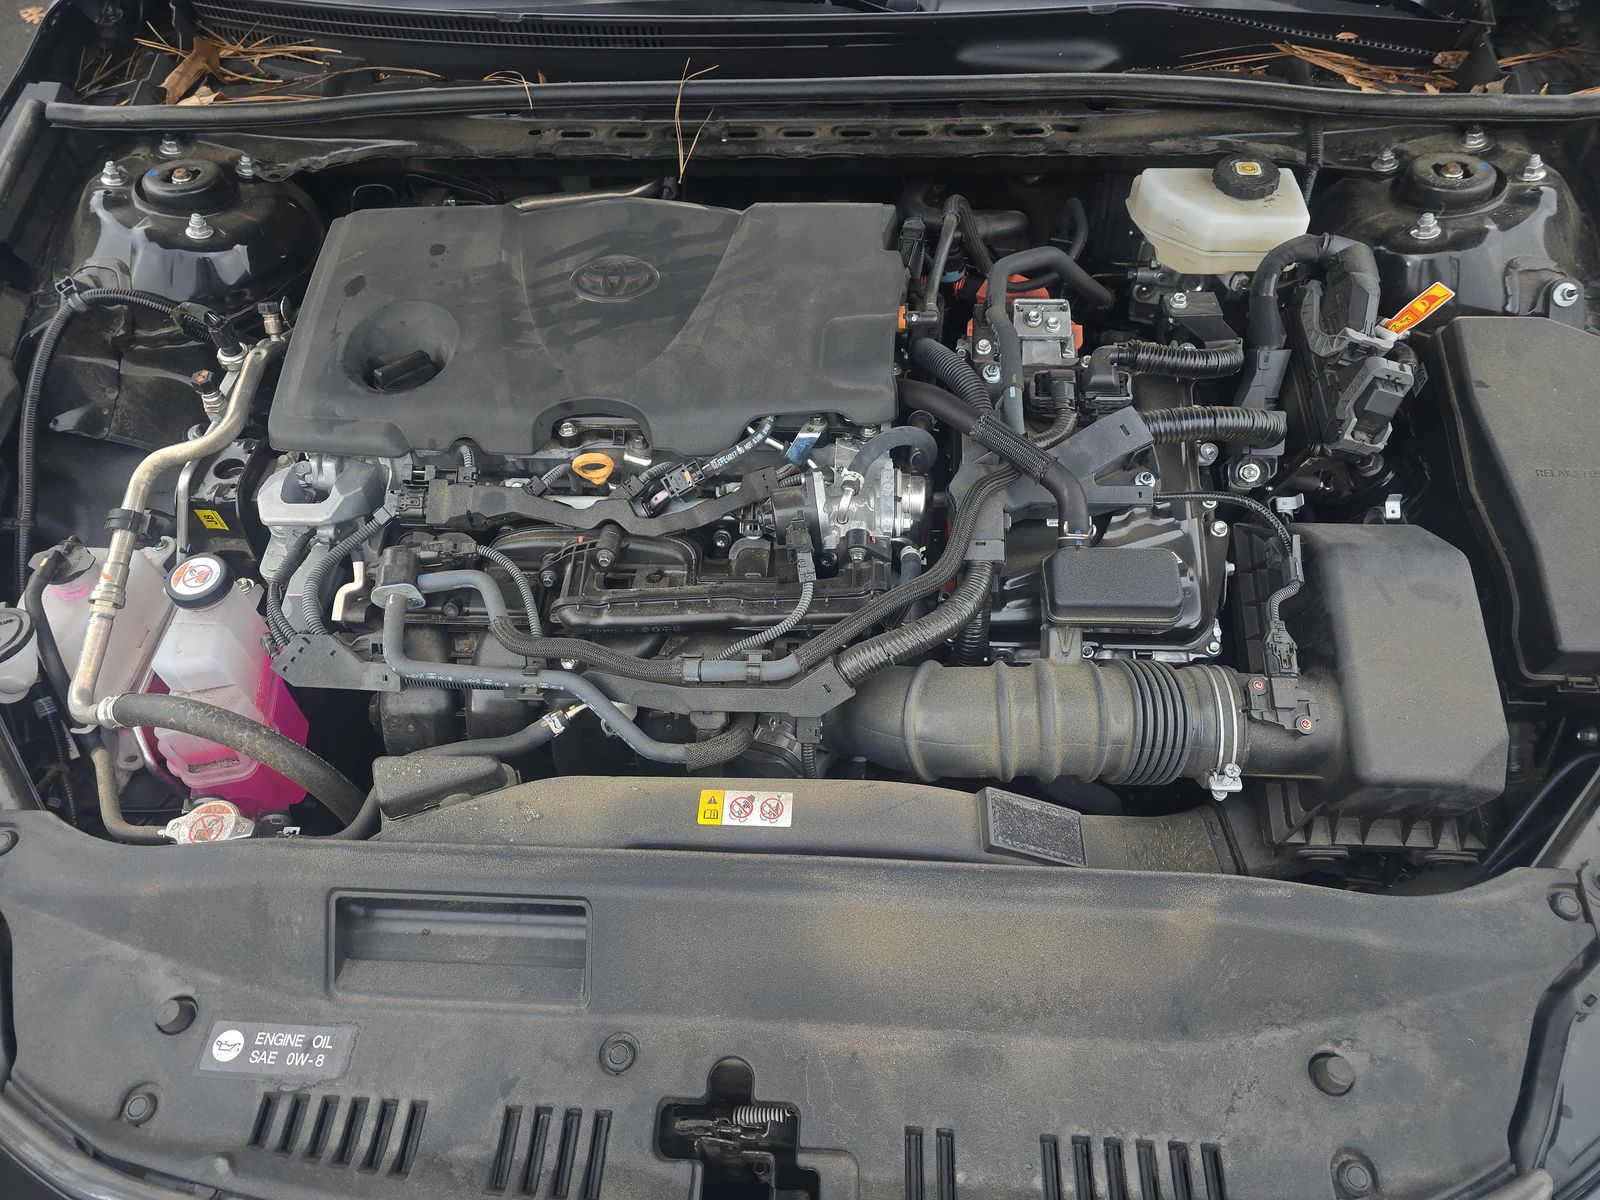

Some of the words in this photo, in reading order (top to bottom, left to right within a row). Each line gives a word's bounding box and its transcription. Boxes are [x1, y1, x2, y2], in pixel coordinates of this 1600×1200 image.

[254, 1031, 305, 1047] ENGINE
[312, 1035, 333, 1049] OIL
[249, 1050, 279, 1065] SAE
[286, 1052, 325, 1067] 0W-8
